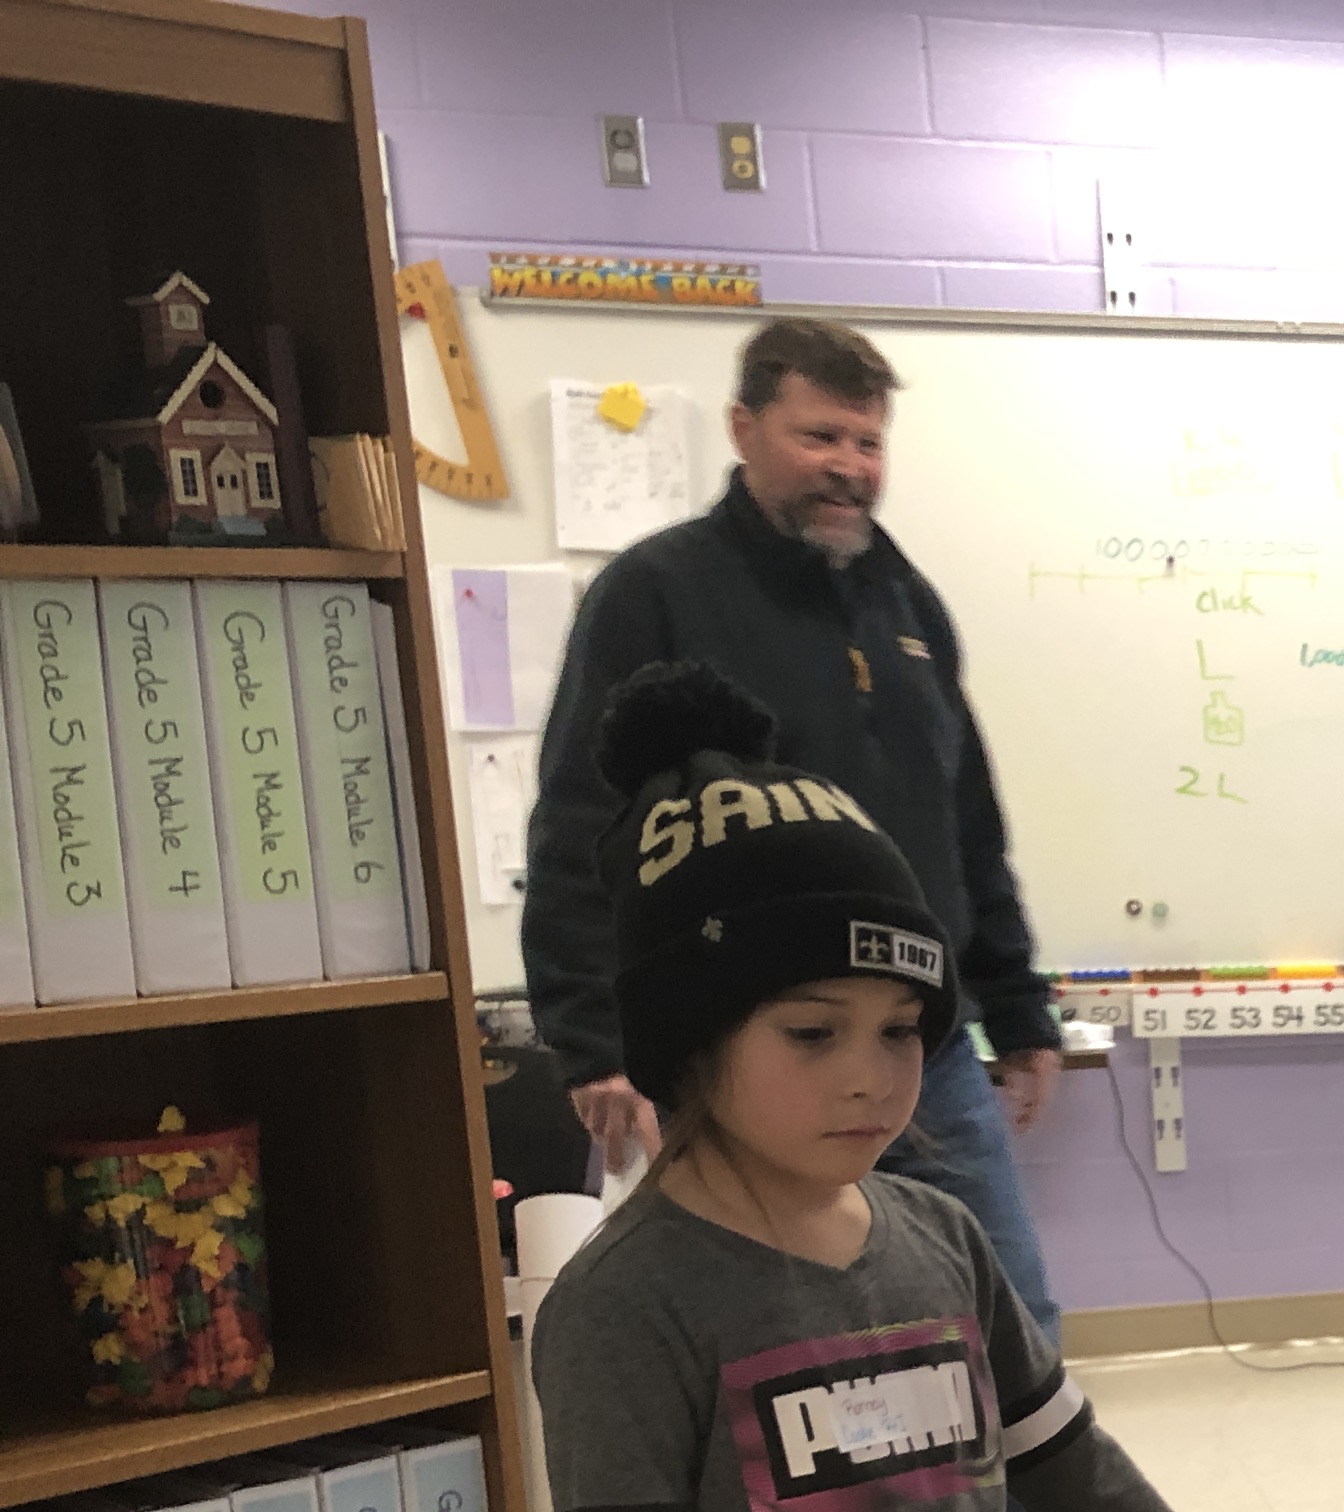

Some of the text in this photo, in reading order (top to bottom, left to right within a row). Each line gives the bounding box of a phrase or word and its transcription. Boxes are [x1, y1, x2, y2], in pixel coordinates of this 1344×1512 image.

[491, 266, 760, 306] WELCOME BACK
[33, 600, 102, 907] Grade 5 Module 3
[127, 602, 200, 897] Grade 5 Module 4
[223, 610, 299, 895] Grade 5 Module 5
[320, 595, 385, 884] Grade 5 Module 6
[1176, 765, 1208, 797] 2
[1089, 1005, 1122, 1023] 50
[1143, 1008, 1167, 1032] 51
[1184, 1008, 1216, 1031] 52
[1229, 1006, 1262, 1029] 53
[1272, 1005, 1304, 1028] 54
